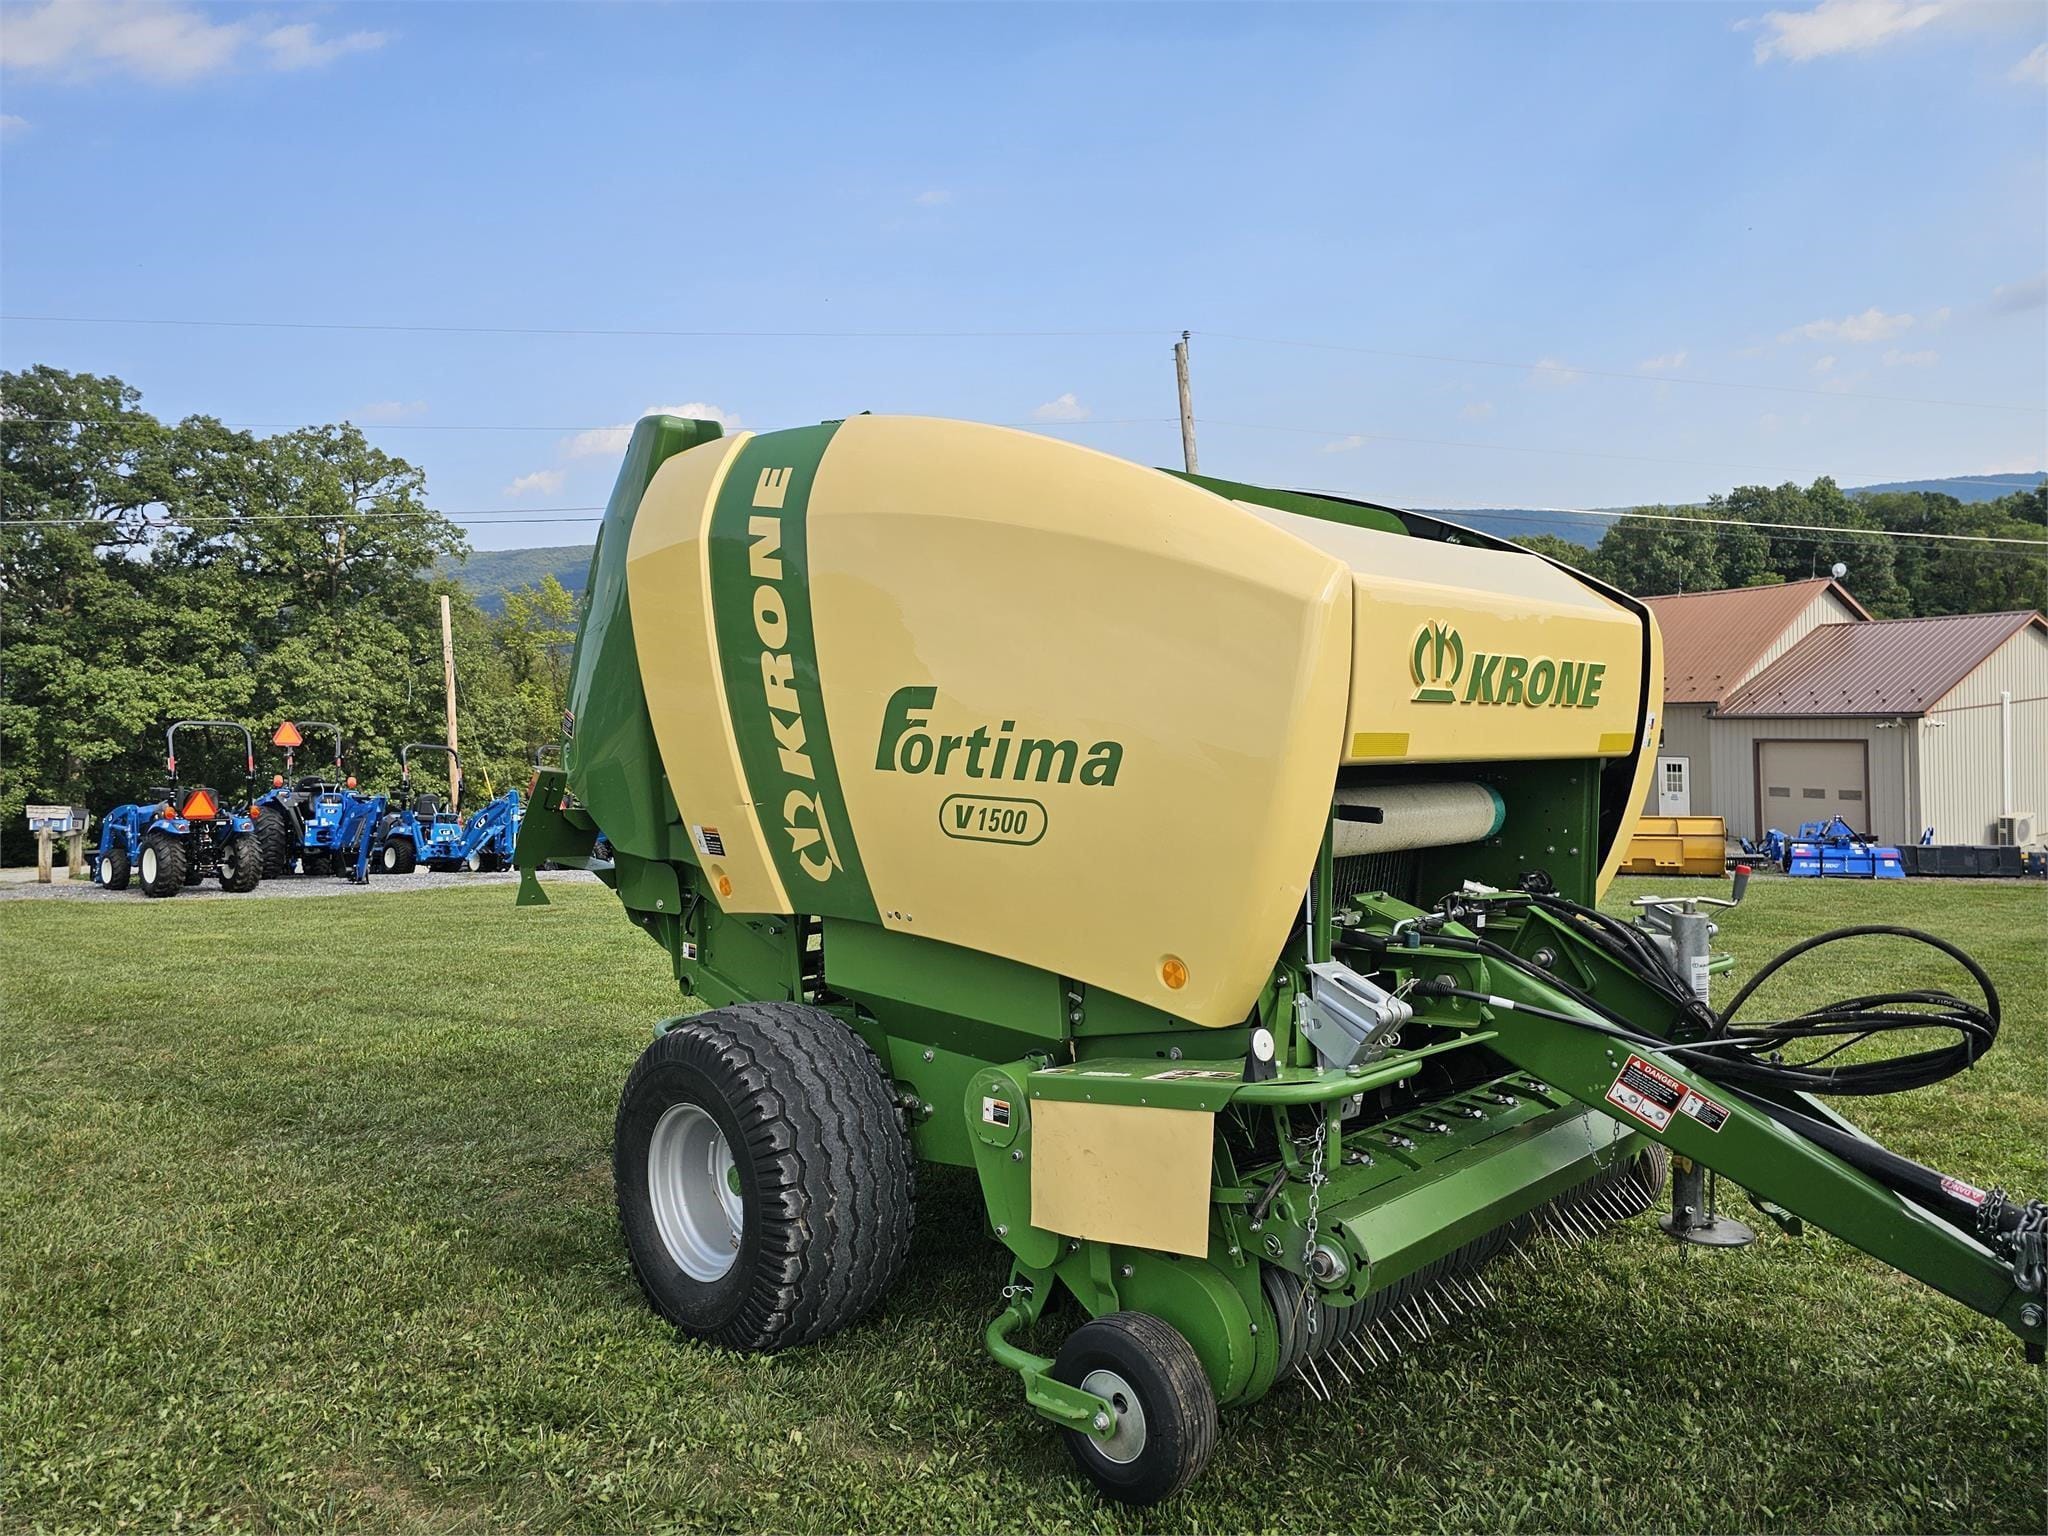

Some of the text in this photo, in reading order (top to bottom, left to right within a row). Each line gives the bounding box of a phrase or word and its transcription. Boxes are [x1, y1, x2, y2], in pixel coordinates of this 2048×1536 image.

[749, 467, 815, 780] KRONE
[1462, 653, 1606, 706] KRONE
[874, 686, 1124, 787] Fortima
[955, 804, 1028, 835] V 1500
[1644, 1065, 1679, 1090] DANGER
